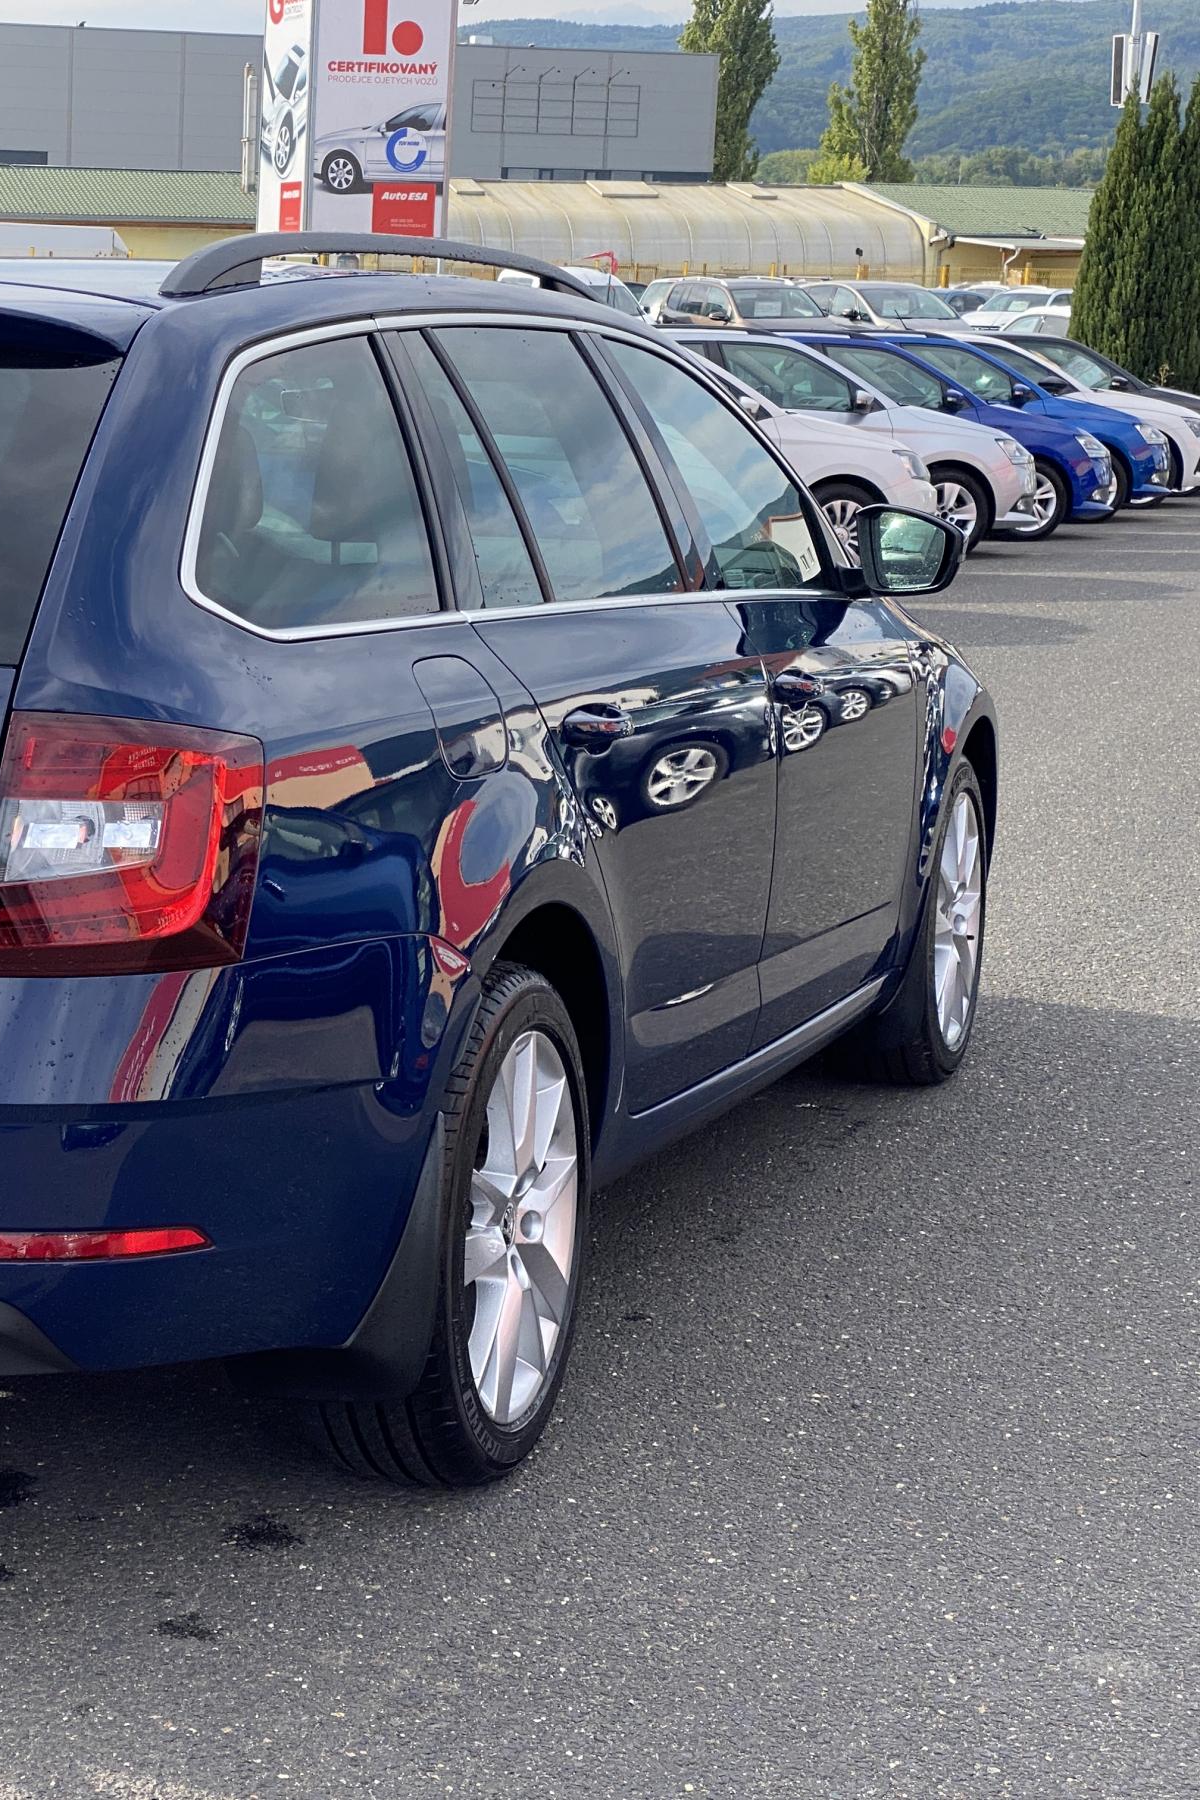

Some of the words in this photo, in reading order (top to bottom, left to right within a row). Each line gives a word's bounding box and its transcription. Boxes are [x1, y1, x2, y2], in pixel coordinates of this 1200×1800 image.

[327, 61, 438, 75] CERTIFIKOVANÝ
[327, 74, 373, 84] PRODEJCE
[381, 191, 407, 201] Auto
[408, 192, 428, 201] ESA
